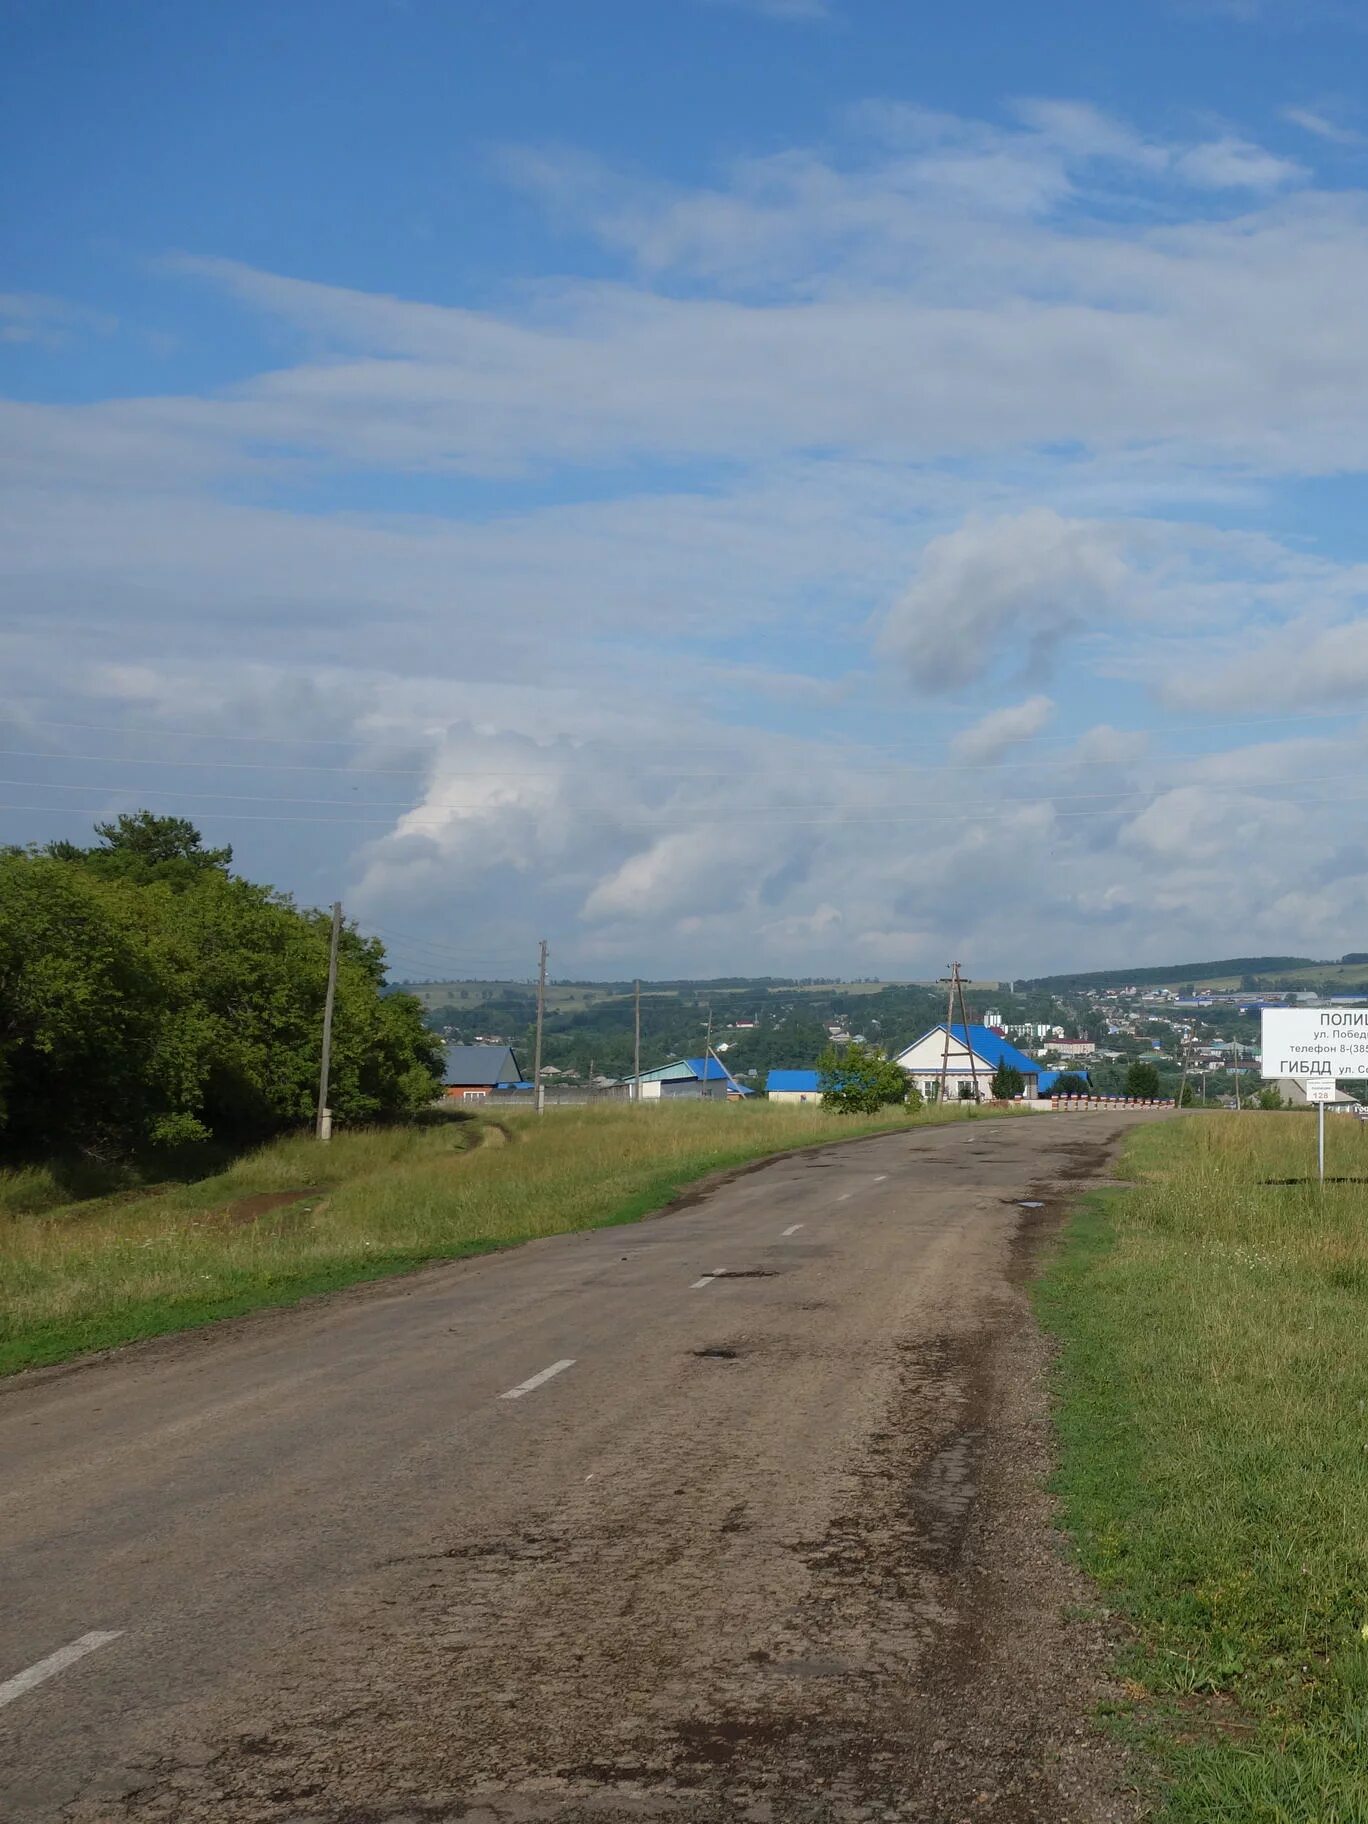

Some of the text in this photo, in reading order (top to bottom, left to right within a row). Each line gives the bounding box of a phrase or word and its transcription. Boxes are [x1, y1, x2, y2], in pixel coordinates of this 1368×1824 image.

[1313, 1031, 1329, 1040] ул.
[1290, 1045, 1336, 1055] телефон
[1280, 1060, 1332, 1075] ГИБДД
[1339, 1066, 1355, 1076] ул.
